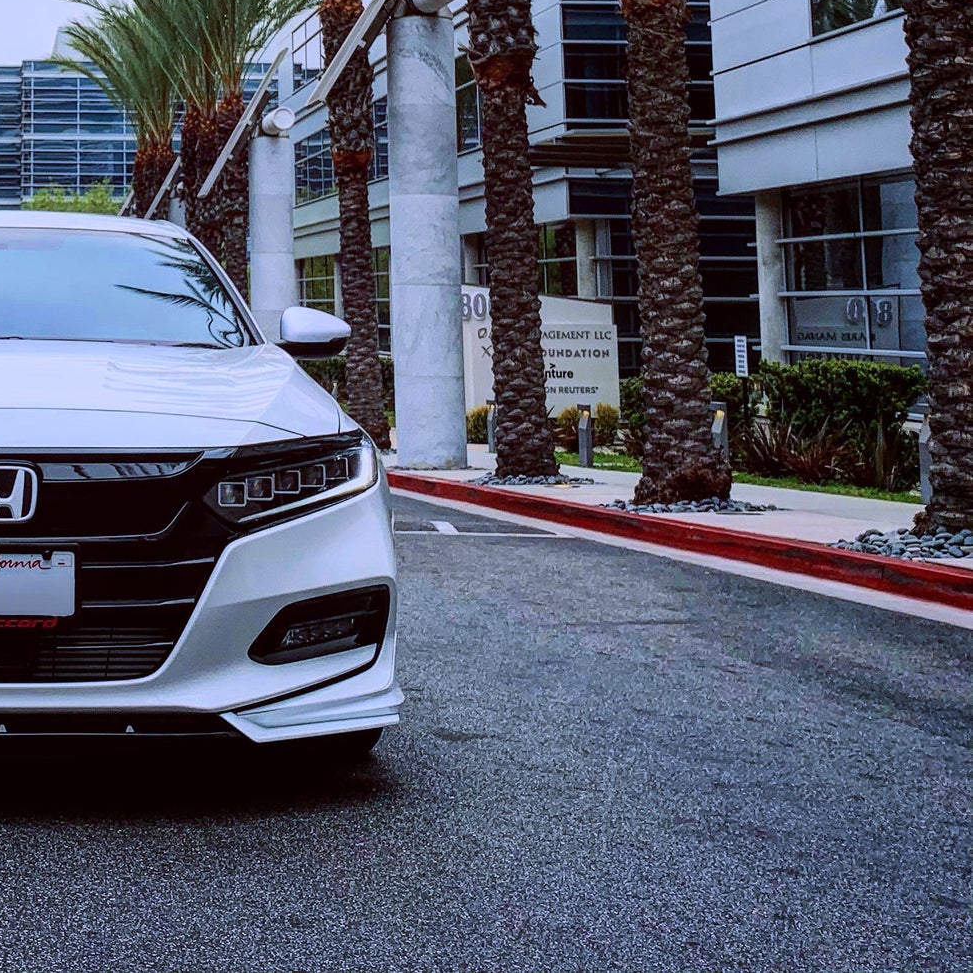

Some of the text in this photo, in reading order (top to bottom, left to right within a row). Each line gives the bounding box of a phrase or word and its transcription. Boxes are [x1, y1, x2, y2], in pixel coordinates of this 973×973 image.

[461, 293, 491, 318] 80
[542, 330, 612, 340] AGEMENT LLC
[543, 349, 610, 358] OUNDATION
[545, 369, 574, 379] nture
